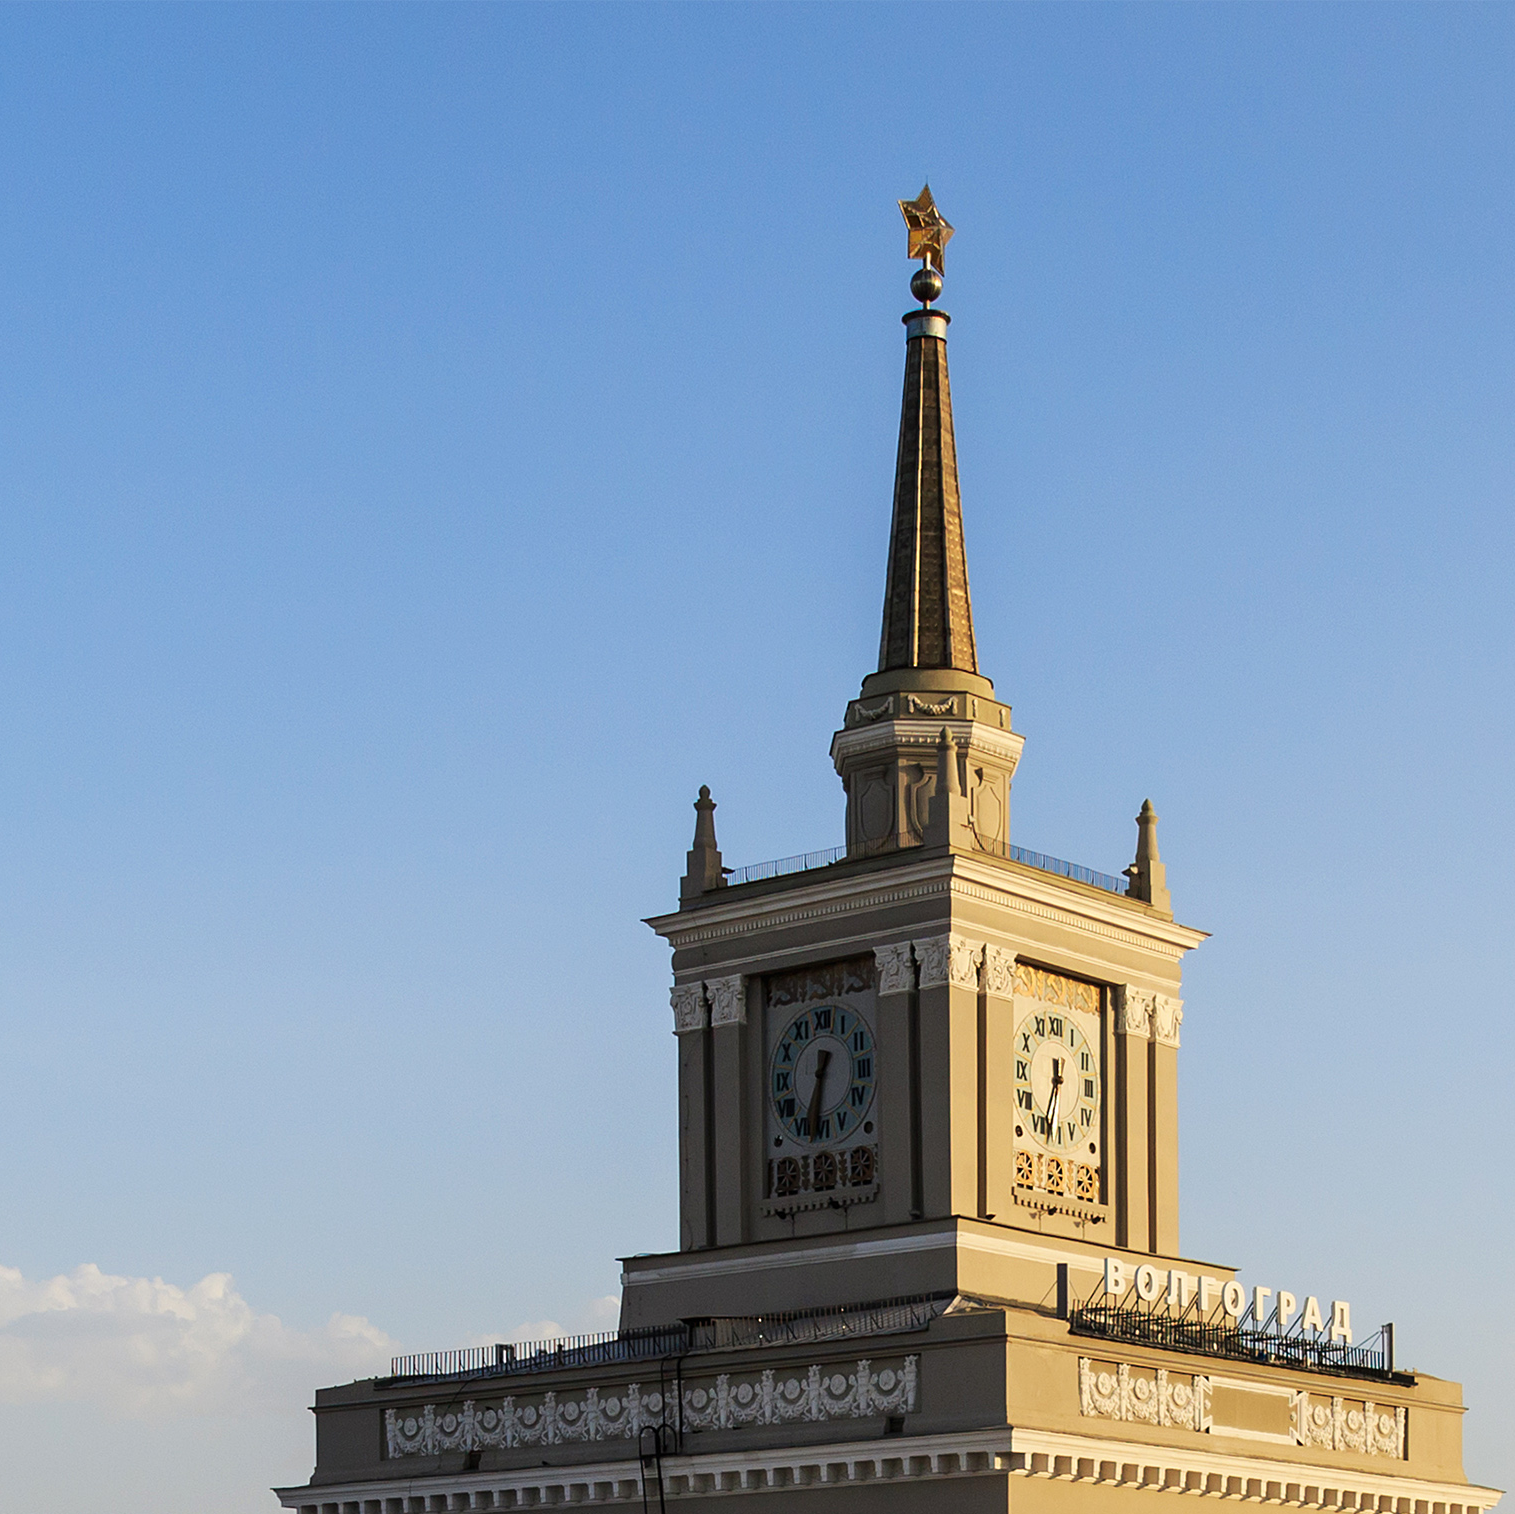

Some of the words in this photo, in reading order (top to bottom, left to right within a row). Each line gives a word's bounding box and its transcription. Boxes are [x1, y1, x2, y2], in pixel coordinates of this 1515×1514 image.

[794, 1021, 809, 1040] XI
[814, 1009, 831, 1031] XII
[1034, 1016, 1045, 1037] XI
[1049, 1016, 1063, 1038] XII
[782, 1042, 792, 1062] X
[854, 1031, 864, 1052] II
[1022, 1032, 1030, 1053] X
[857, 1058, 871, 1079] III
[1016, 1060, 1028, 1081] IX
[1081, 1052, 1089, 1072] II
[777, 1072, 790, 1092] IX
[1084, 1079, 1094, 1098] III
[852, 1086, 866, 1107] IV
[837, 1112, 847, 1131] V
[1081, 1107, 1092, 1127] IV
[1067, 1122, 1076, 1141] V
[1104, 1257, 1352, 1344] ВОЛГОГРАД
